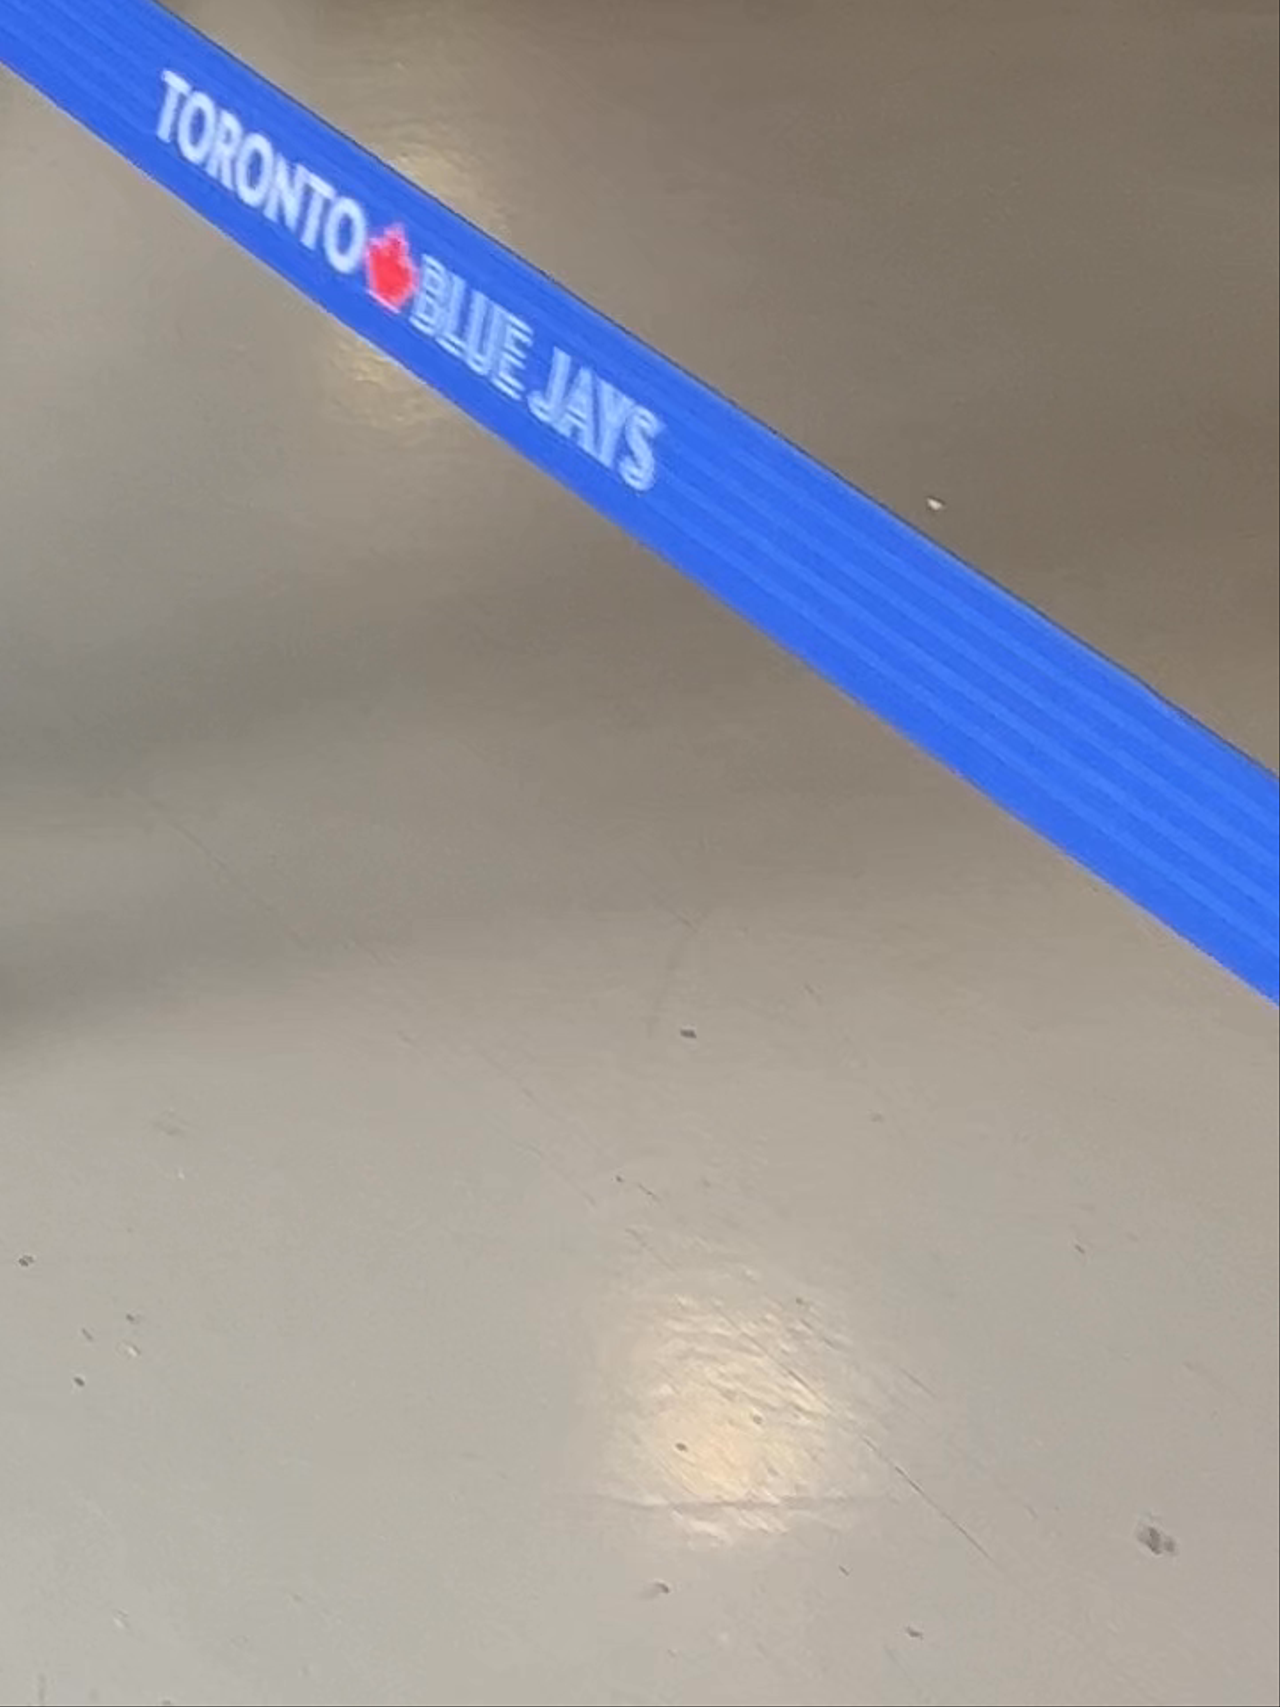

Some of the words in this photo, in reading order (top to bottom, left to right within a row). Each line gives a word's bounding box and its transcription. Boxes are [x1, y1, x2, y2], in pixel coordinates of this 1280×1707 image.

[155, 69, 368, 274] TORONTO
[408, 252, 535, 401] BLUE
[526, 345, 666, 492] JAYS
